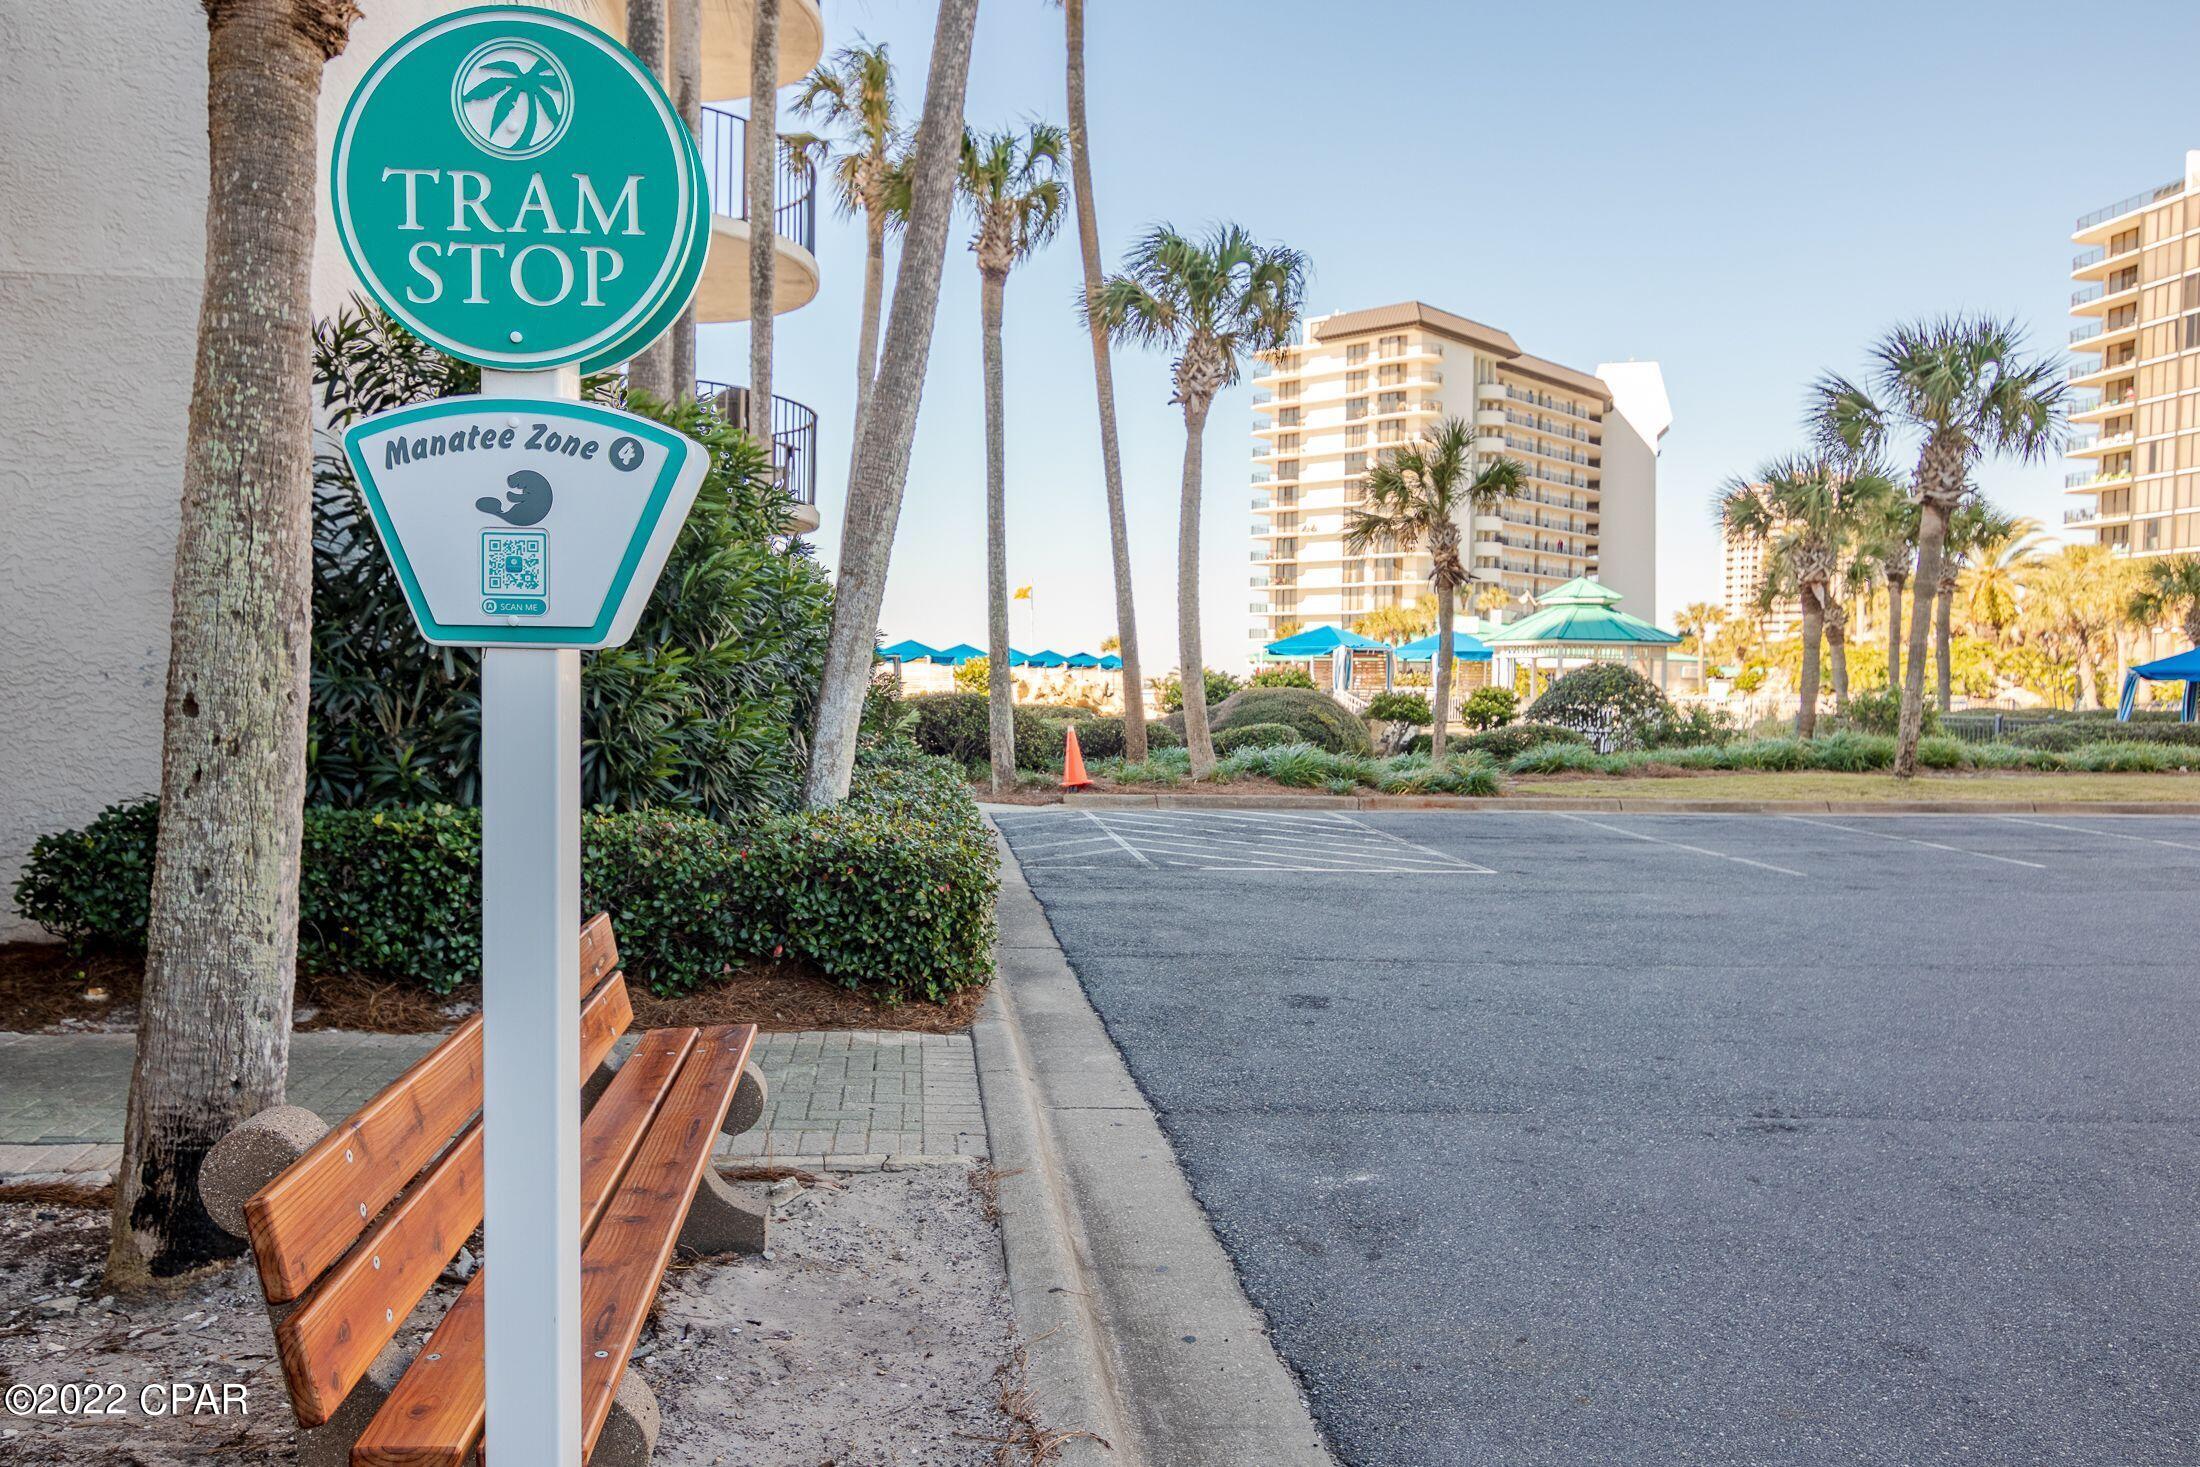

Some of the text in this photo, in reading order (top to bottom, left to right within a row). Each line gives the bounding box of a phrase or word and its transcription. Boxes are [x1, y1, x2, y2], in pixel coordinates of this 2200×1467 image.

[382, 166, 646, 236] TRAM
[406, 241, 625, 307] STOP
[385, 423, 636, 470] Manatee Zone 4
[500, 603, 538, 611] SCAN ME
